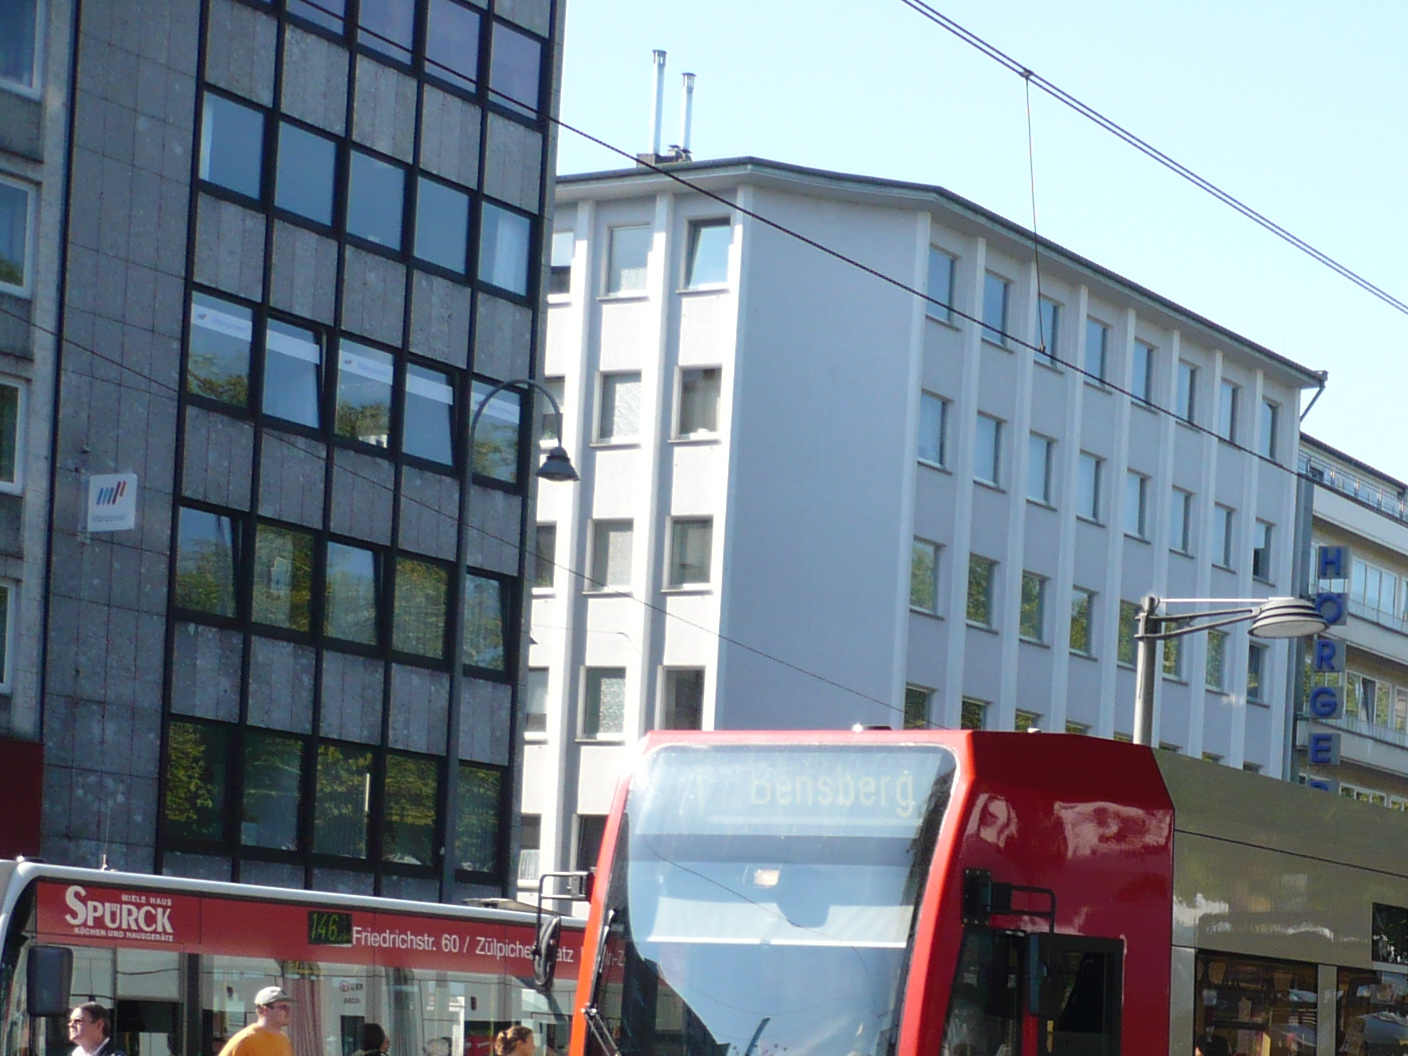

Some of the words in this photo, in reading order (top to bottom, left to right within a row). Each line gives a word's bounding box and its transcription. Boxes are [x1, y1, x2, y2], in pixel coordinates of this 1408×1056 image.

[751, 761, 914, 818] Bensberg
[150, 897, 172, 906] HAUS
[74, 927, 106, 937] KÜCHEN
[107, 930, 124, 938] UND
[311, 912, 339, 941] 146
[352, 927, 437, 952] Friedrichstr.
[441, 934, 460, 953] 60
[463, 936, 470, 954] /
